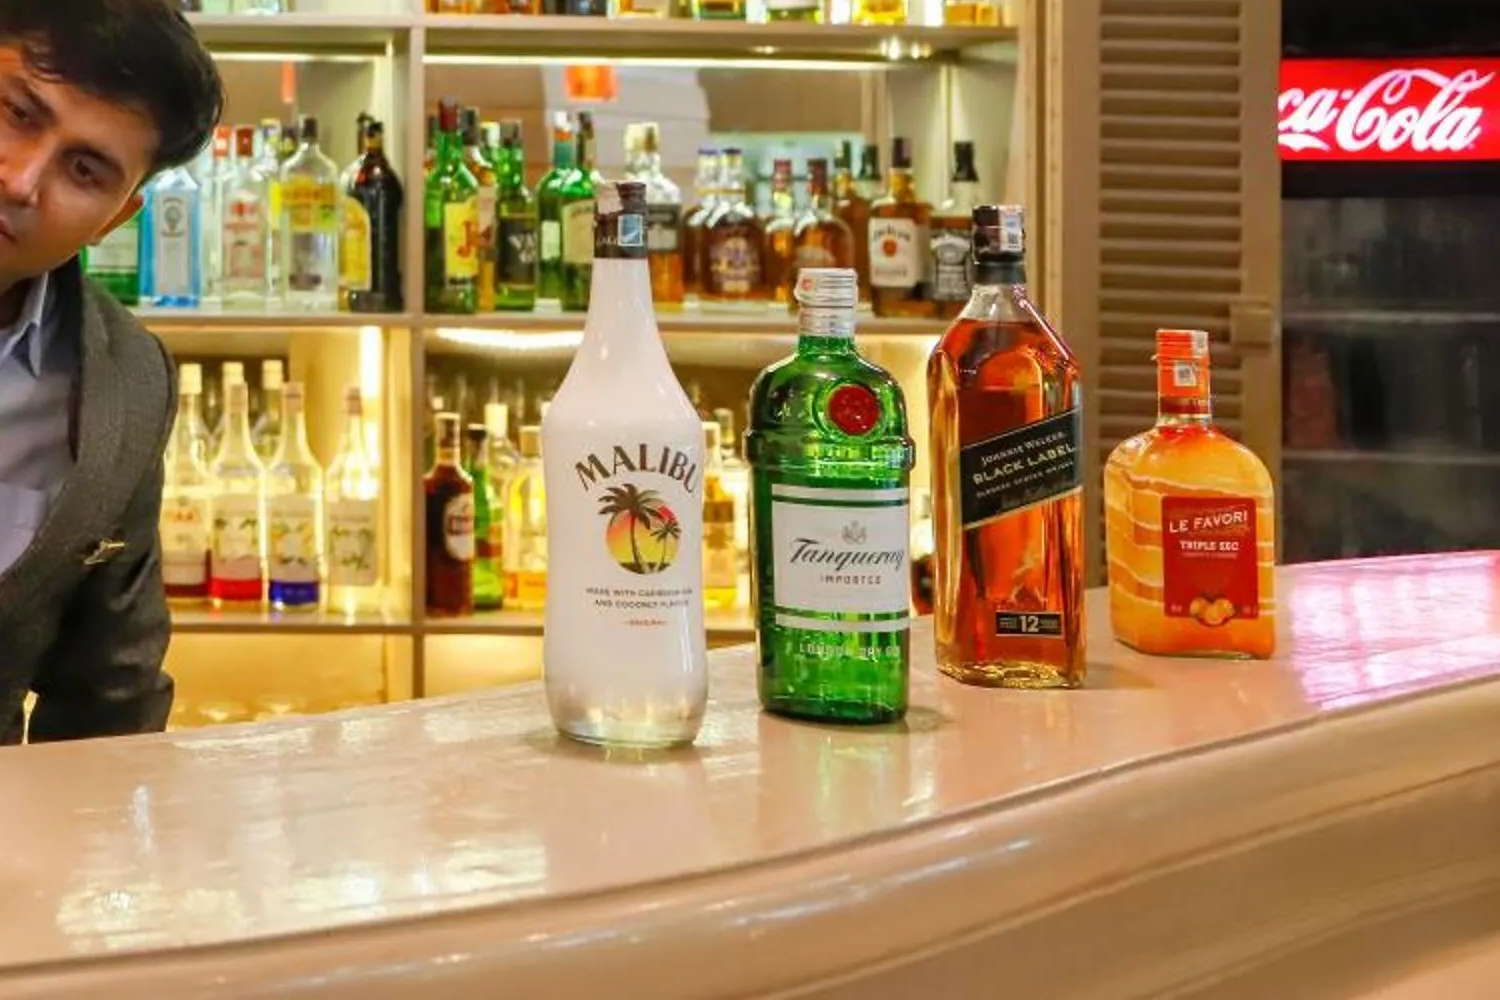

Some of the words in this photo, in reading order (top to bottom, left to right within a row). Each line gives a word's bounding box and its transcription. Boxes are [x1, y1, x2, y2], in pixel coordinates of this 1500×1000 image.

[1278, 69, 1496, 152] ca-Cola
[1027, 443, 1077, 468] LABEL
[575, 443, 698, 494] MALIBU
[1169, 519, 1189, 534] LE
[1193, 509, 1249, 530] FAVORI
[1019, 614, 1040, 633] 12
